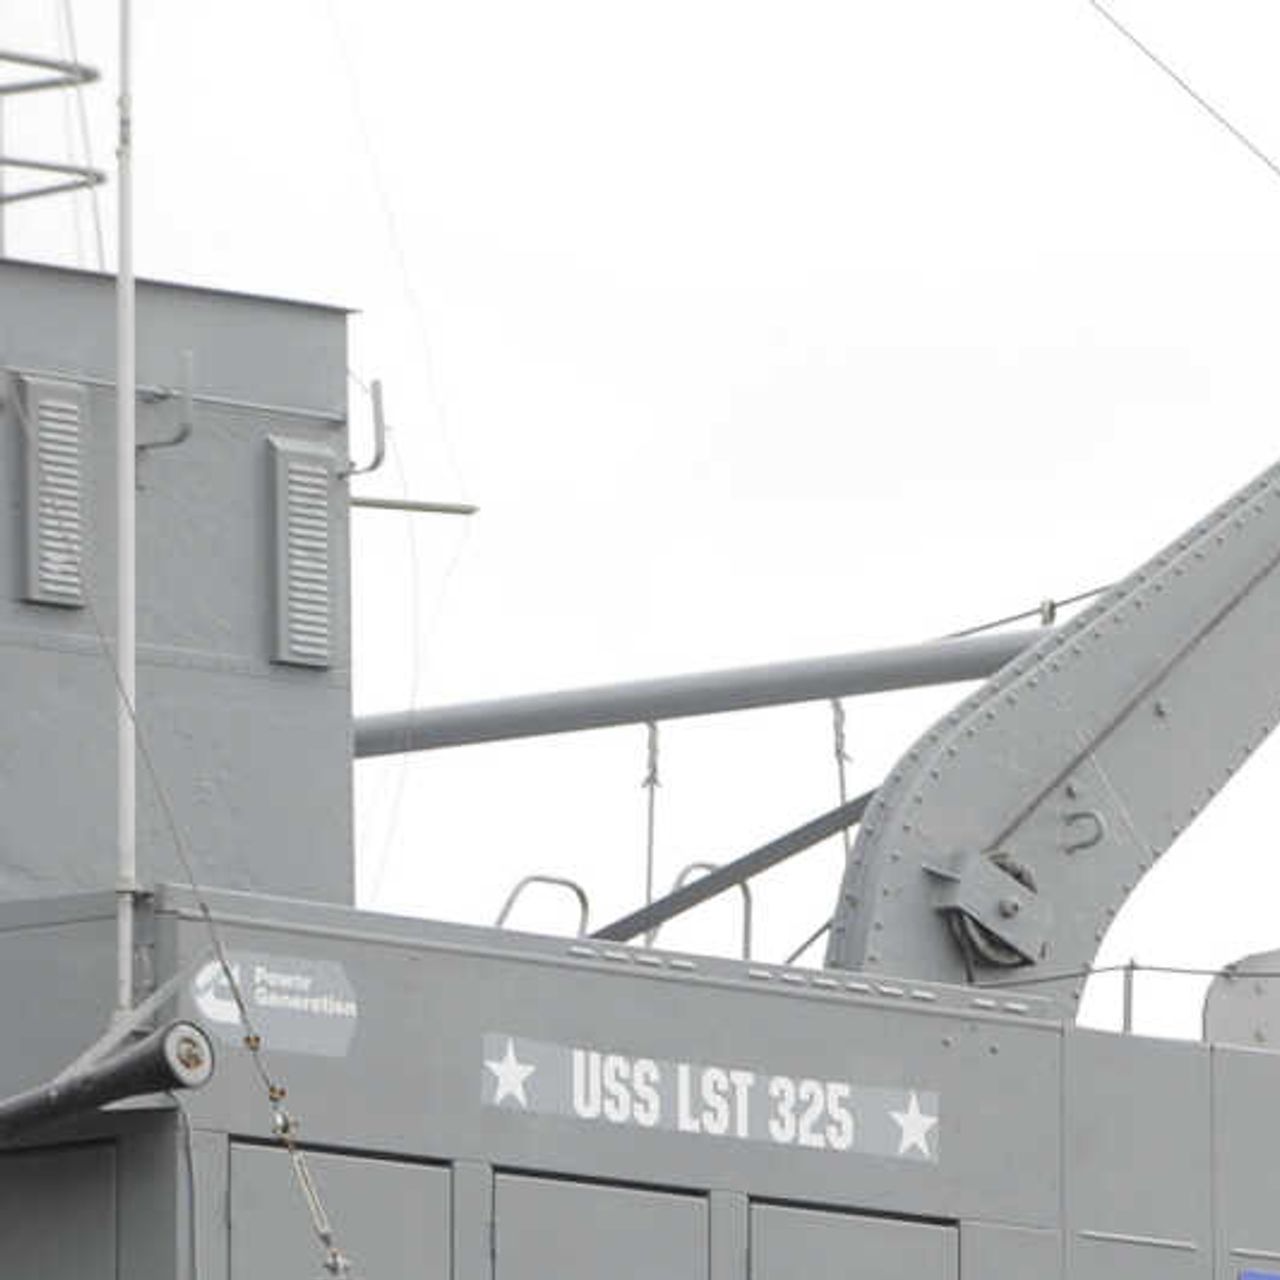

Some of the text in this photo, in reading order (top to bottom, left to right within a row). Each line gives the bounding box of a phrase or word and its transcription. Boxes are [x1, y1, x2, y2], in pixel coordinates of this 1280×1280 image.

[572, 1048, 854, 1151] USS LST 325
